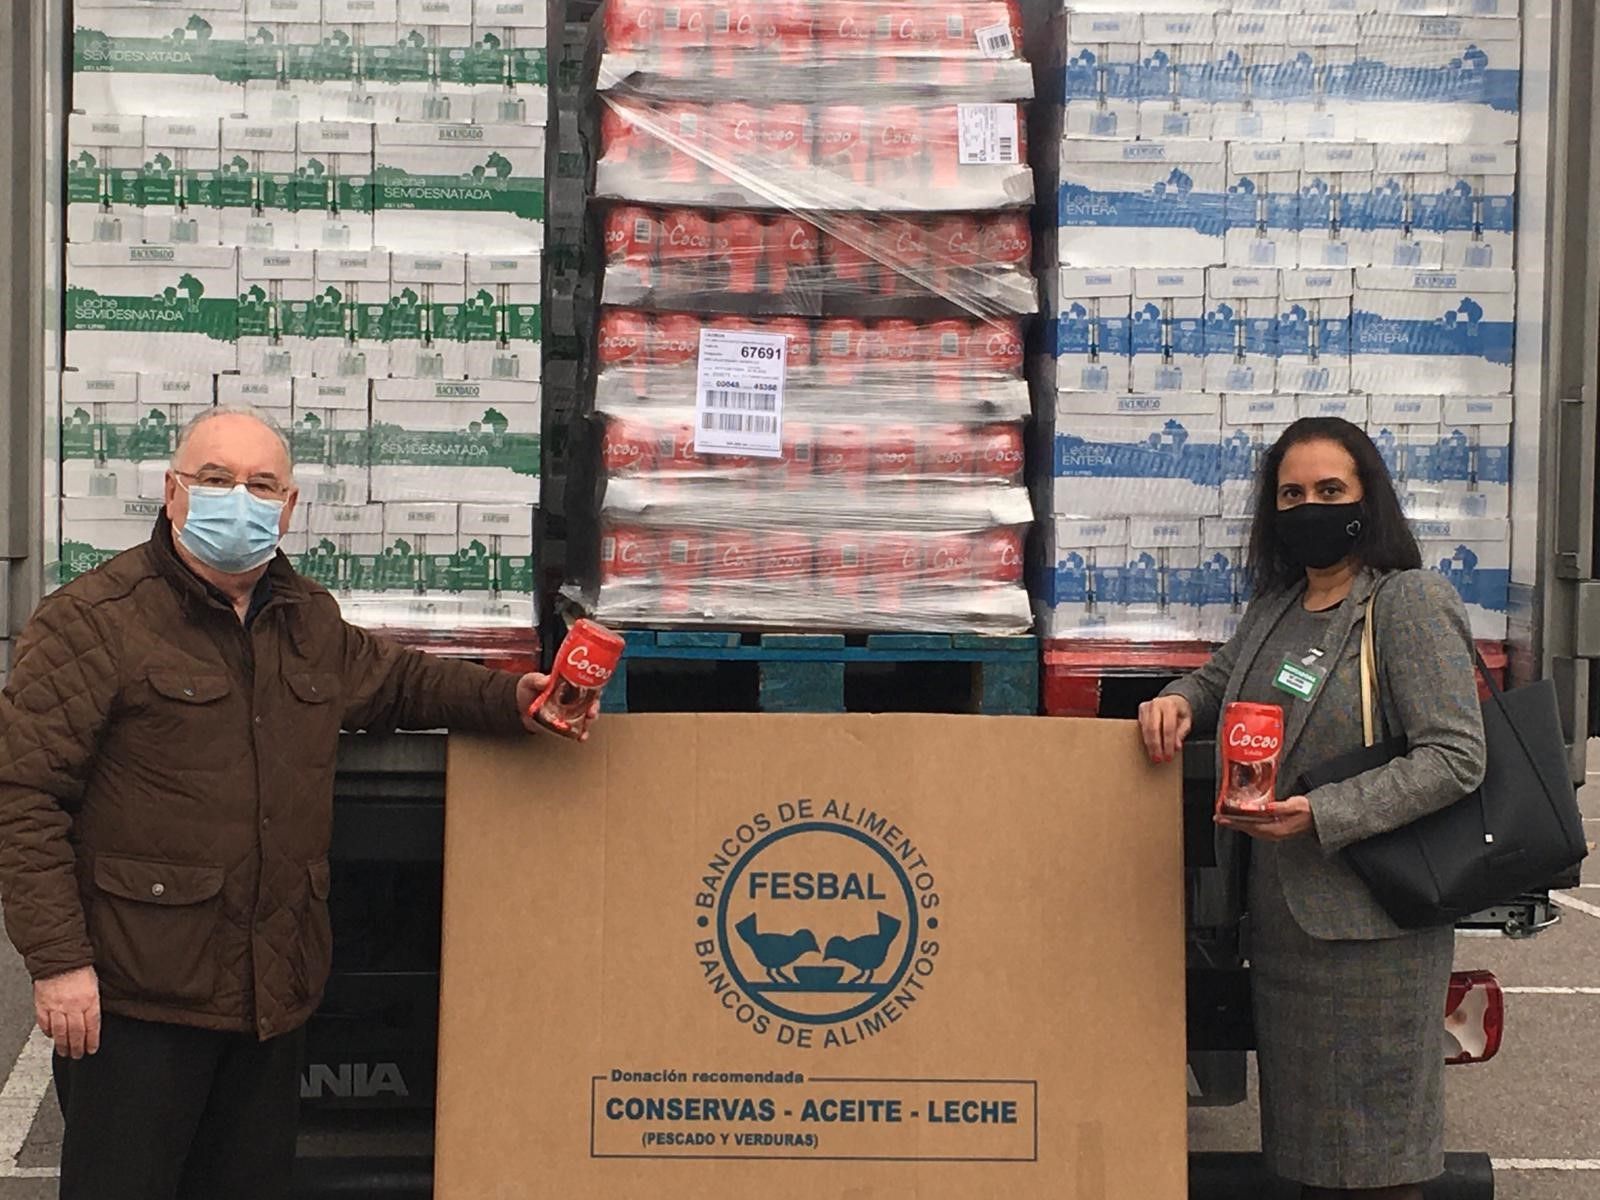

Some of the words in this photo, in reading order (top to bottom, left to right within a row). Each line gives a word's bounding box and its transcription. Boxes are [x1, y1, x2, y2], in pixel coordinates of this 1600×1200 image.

[83, 51, 193, 63] SEMIDESNATADA
[384, 176, 426, 187] Leche
[384, 188, 493, 200] SEMIDESNATADA
[1066, 193, 1108, 206] Leche
[1066, 205, 1118, 217] ENTERA
[75, 297, 118, 310] Leche
[75, 308, 184, 321] SEMIDESNATADA
[1360, 333, 1409, 344] ENTERA
[741, 346, 782, 360] 67691
[380, 443, 489, 456] SEMIDESNATADA
[1062, 456, 1113, 466] ENTERA
[124, 502, 163, 514] HACENDA
[567, 645, 612, 680] Cacao
[1229, 723, 1279, 749] Cacao
[696, 812, 771, 909] BANCOS
[777, 799, 814, 823] DE
[822, 799, 940, 910] ALIMENTOS
[749, 871, 887, 900] FESBAL
[695, 939, 771, 1034] BANCOS
[776, 1024, 813, 1048] DE
[823, 940, 940, 1049] ALIMENTOS
[611, 1069, 687, 1083] Donación
[692, 1070, 804, 1084] recomendada
[606, 1097, 775, 1122] CONSERVAS
[801, 1099, 902, 1122] ACEITE
[928, 1100, 1018, 1124] LECHE
[641, 1131, 716, 1148] (PESCADO
[720, 1133, 730, 1145] Y
[734, 1133, 818, 1149] VERDURAS)
